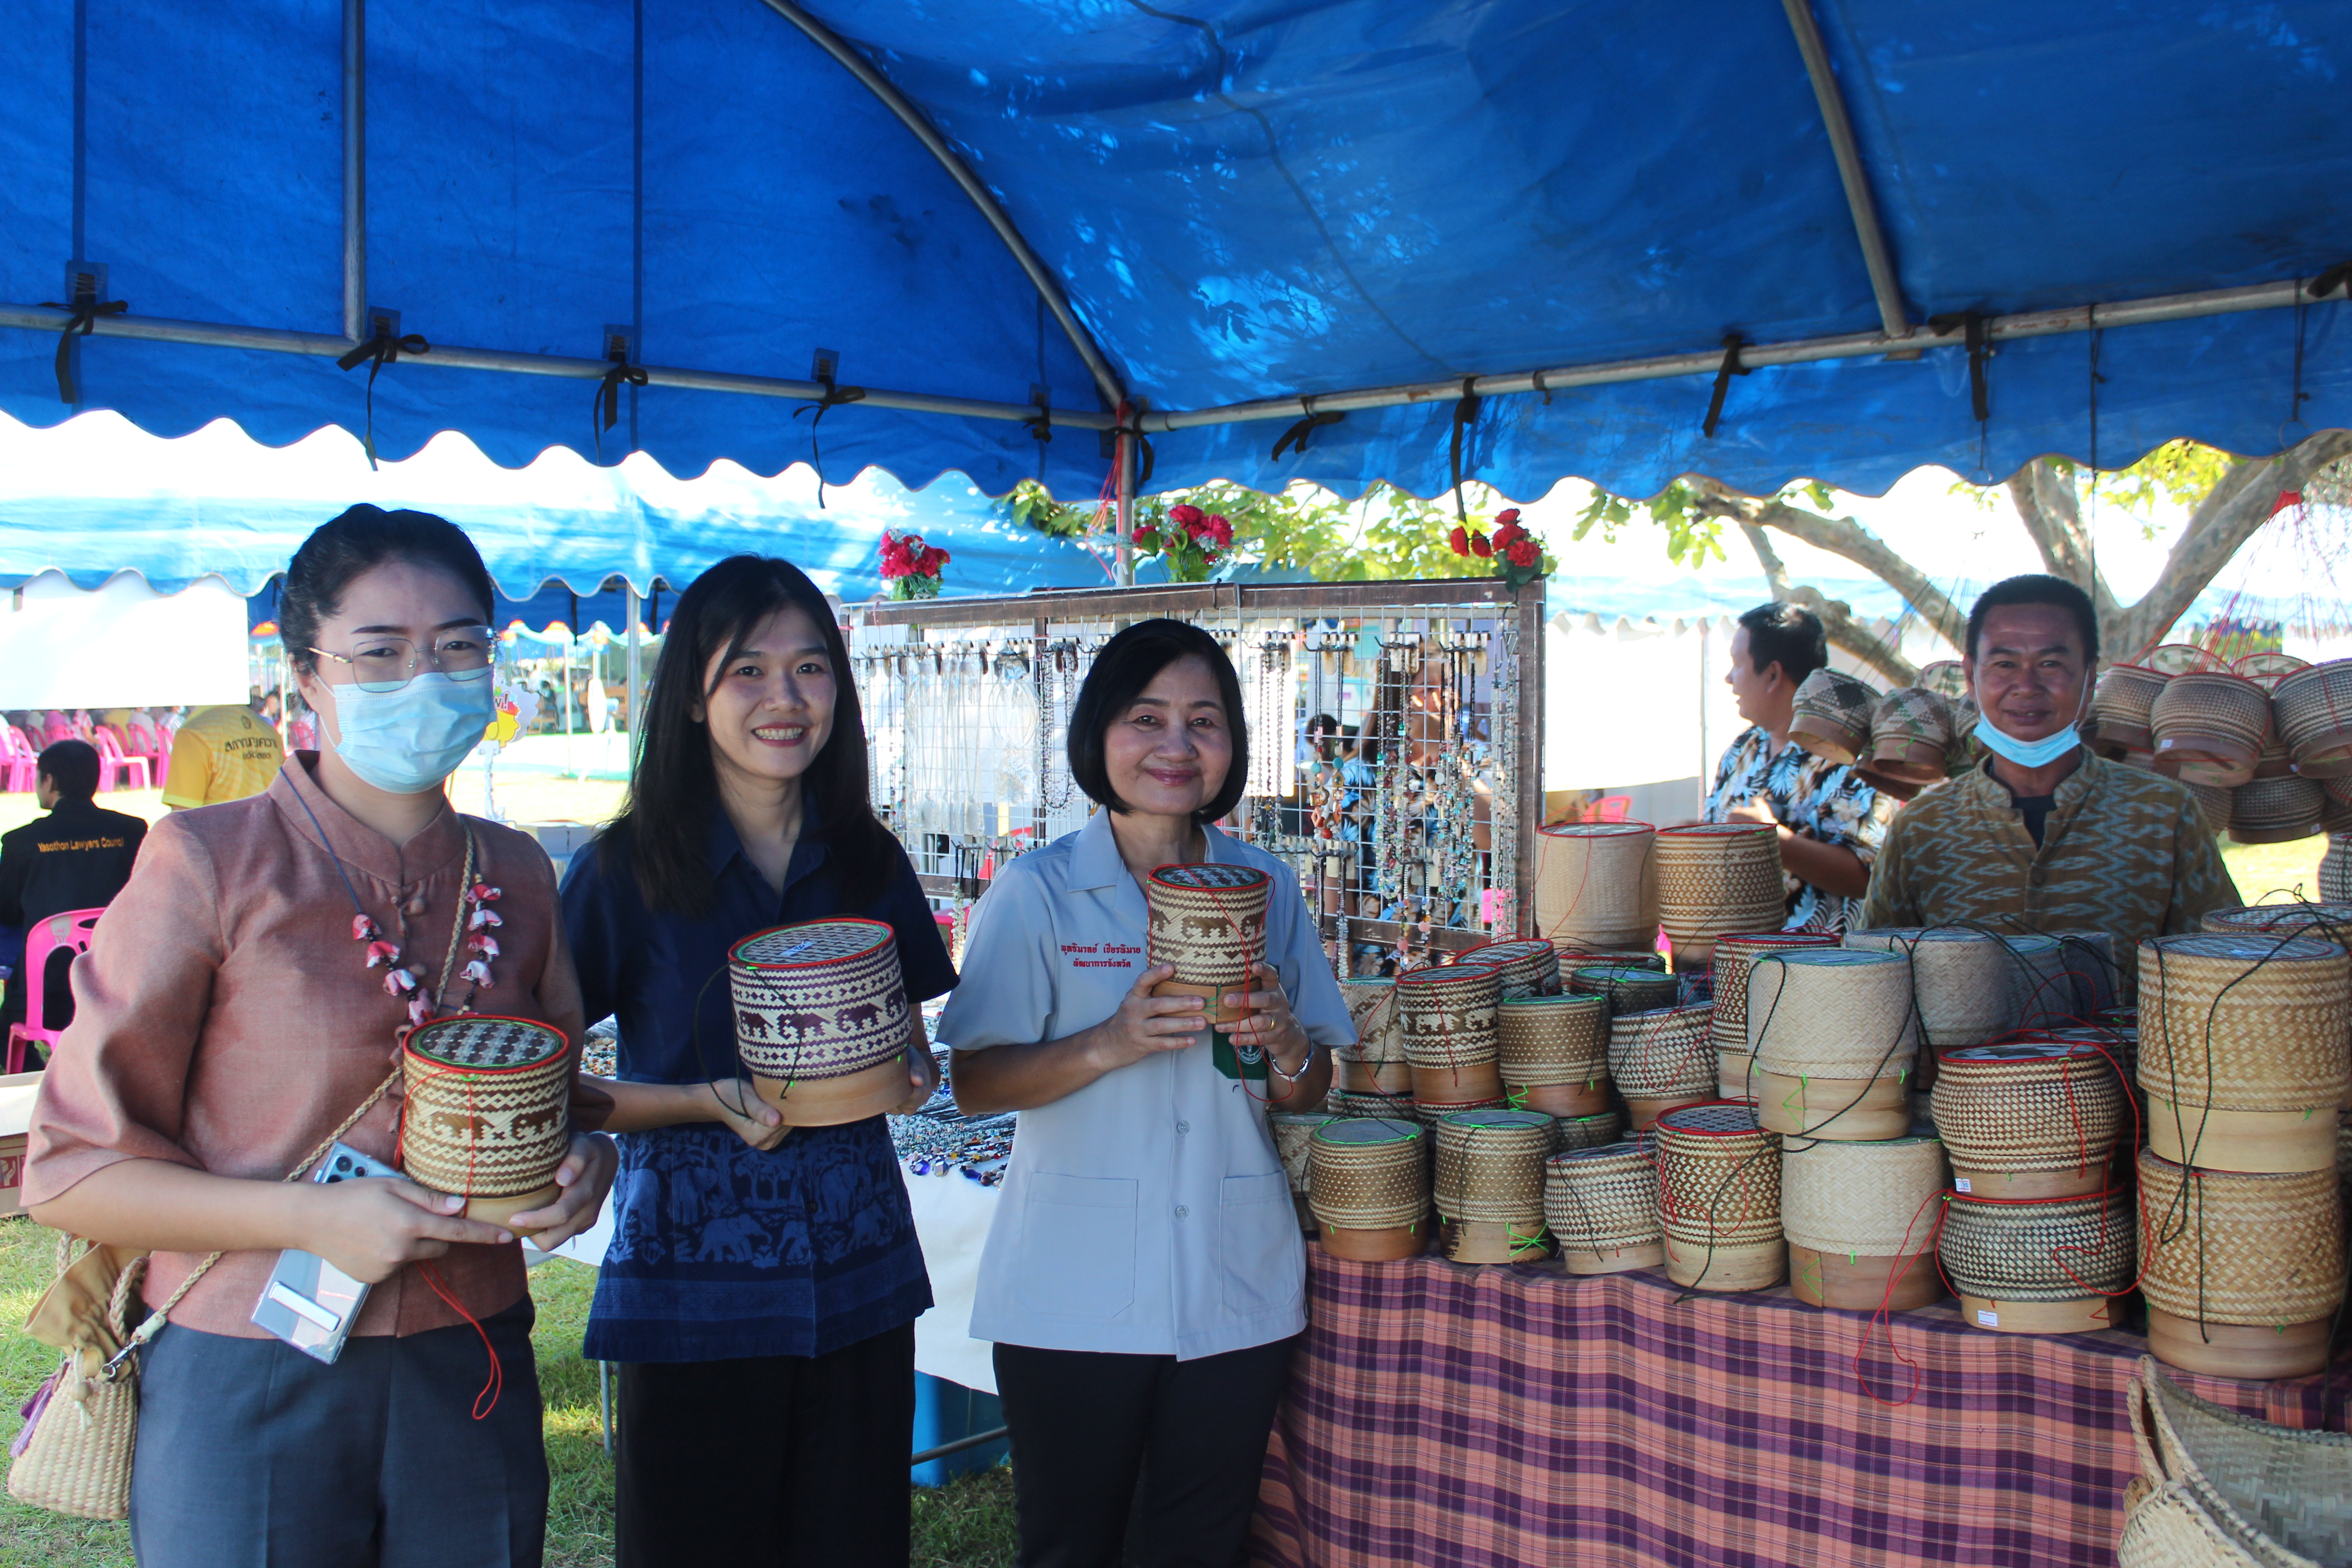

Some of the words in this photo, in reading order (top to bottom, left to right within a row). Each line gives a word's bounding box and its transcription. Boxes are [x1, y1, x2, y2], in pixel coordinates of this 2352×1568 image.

[37, 841, 69, 853] Yasothon
[70, 840, 99, 851] Lawyers
[101, 837, 124, 848] Council
[1073, 957, 1131, 968] พัฒนาการจังหวัด
